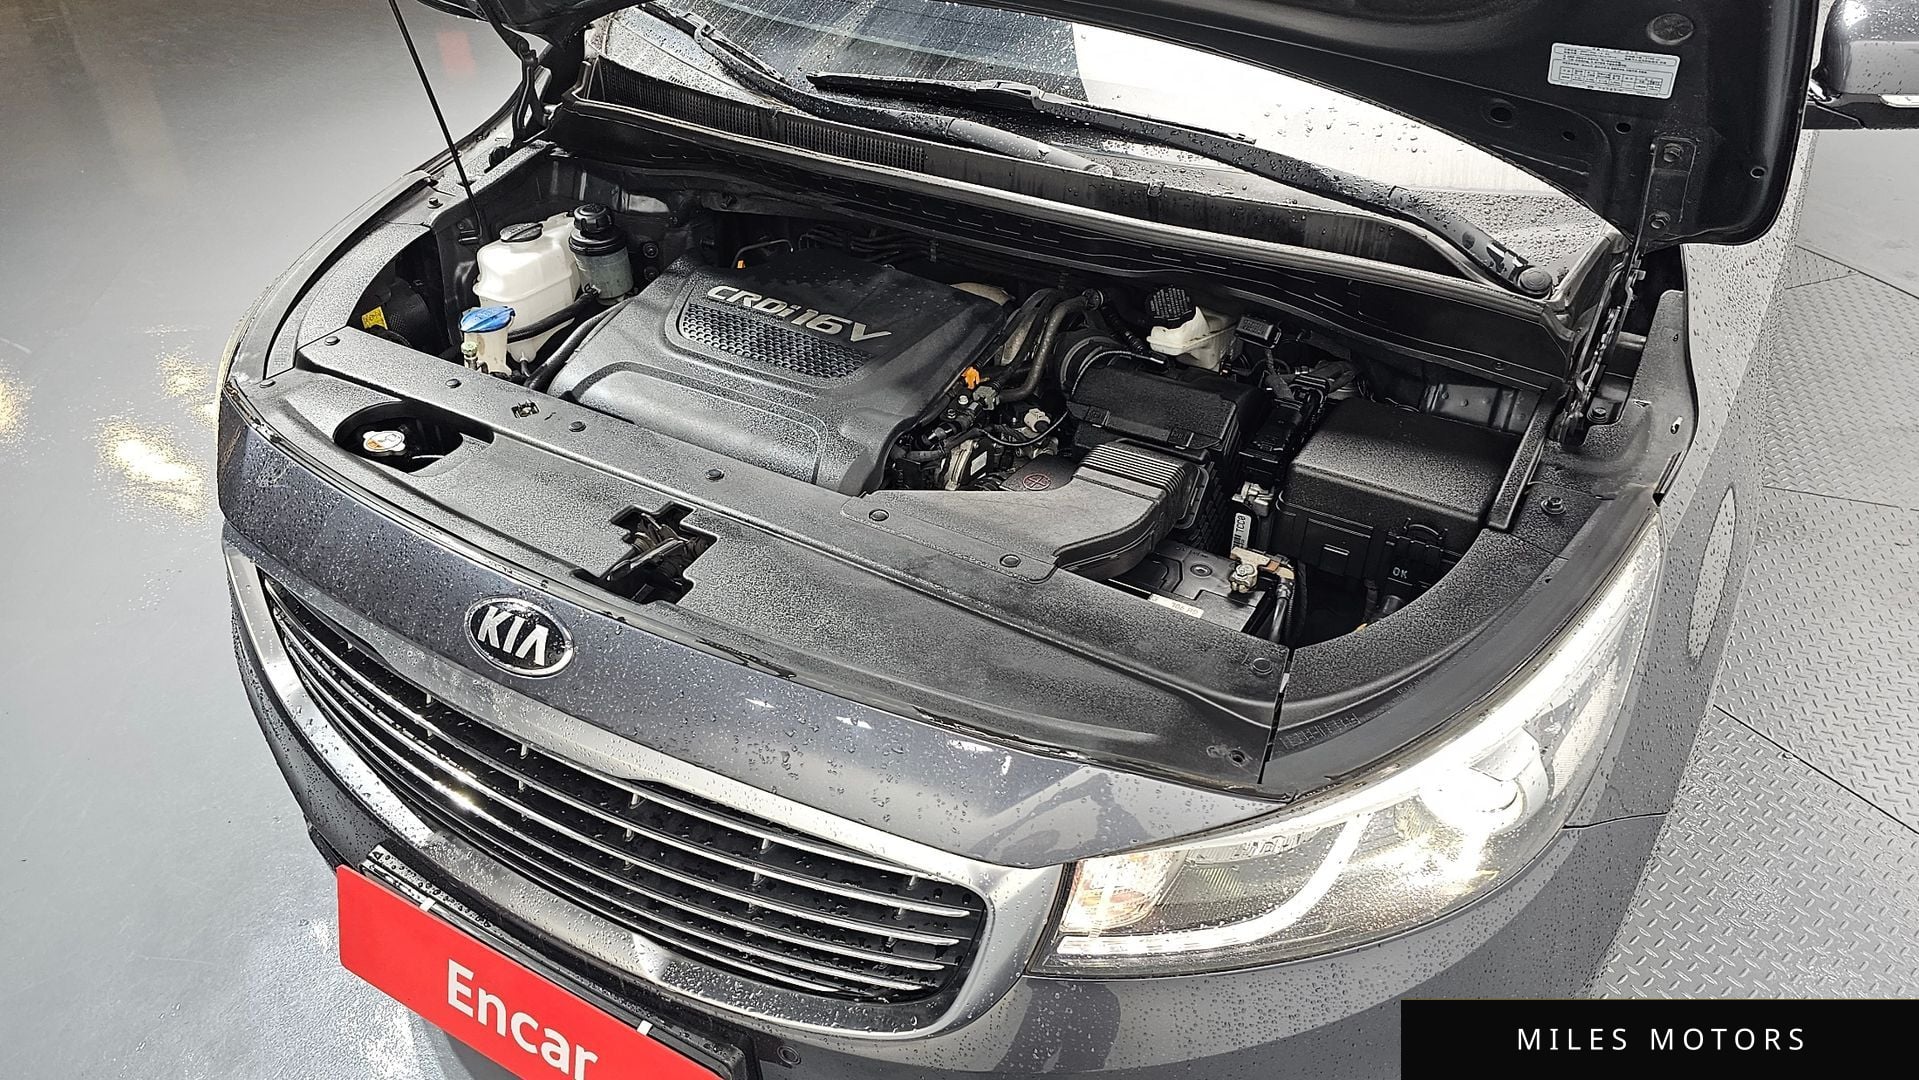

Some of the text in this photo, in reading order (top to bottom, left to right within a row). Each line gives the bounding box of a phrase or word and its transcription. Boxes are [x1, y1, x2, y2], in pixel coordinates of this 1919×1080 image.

[1392, 566, 1408, 579] OK
[477, 605, 549, 666] KIA
[447, 957, 599, 1080] Encar
